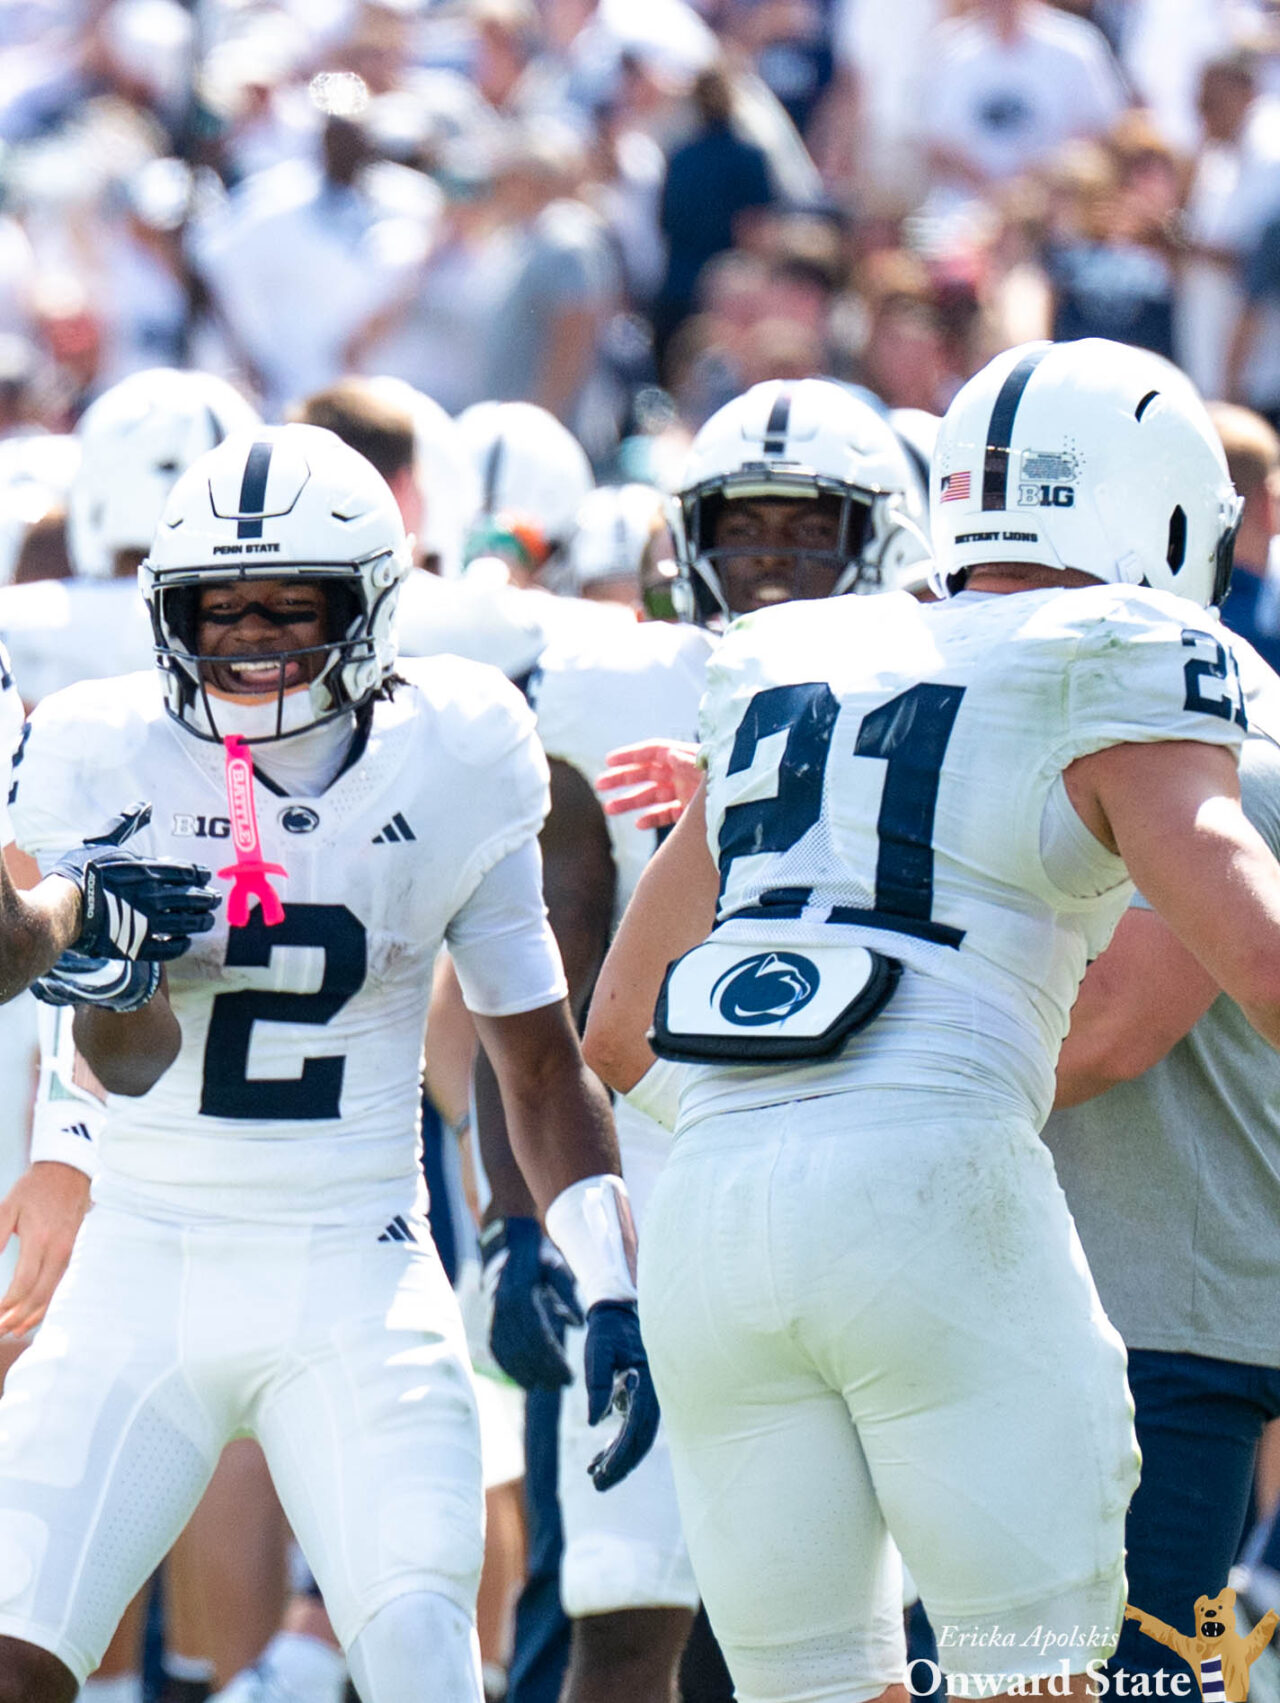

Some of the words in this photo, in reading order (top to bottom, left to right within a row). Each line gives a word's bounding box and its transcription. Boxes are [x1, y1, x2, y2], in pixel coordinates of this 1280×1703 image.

[213, 544, 243, 556] PENN
[245, 543, 280, 554] STATE
[1002, 531, 1038, 543] LIONS
[232, 768, 252, 845] BATTLE
[713, 682, 967, 950] 21
[199, 903, 367, 1121] 2
